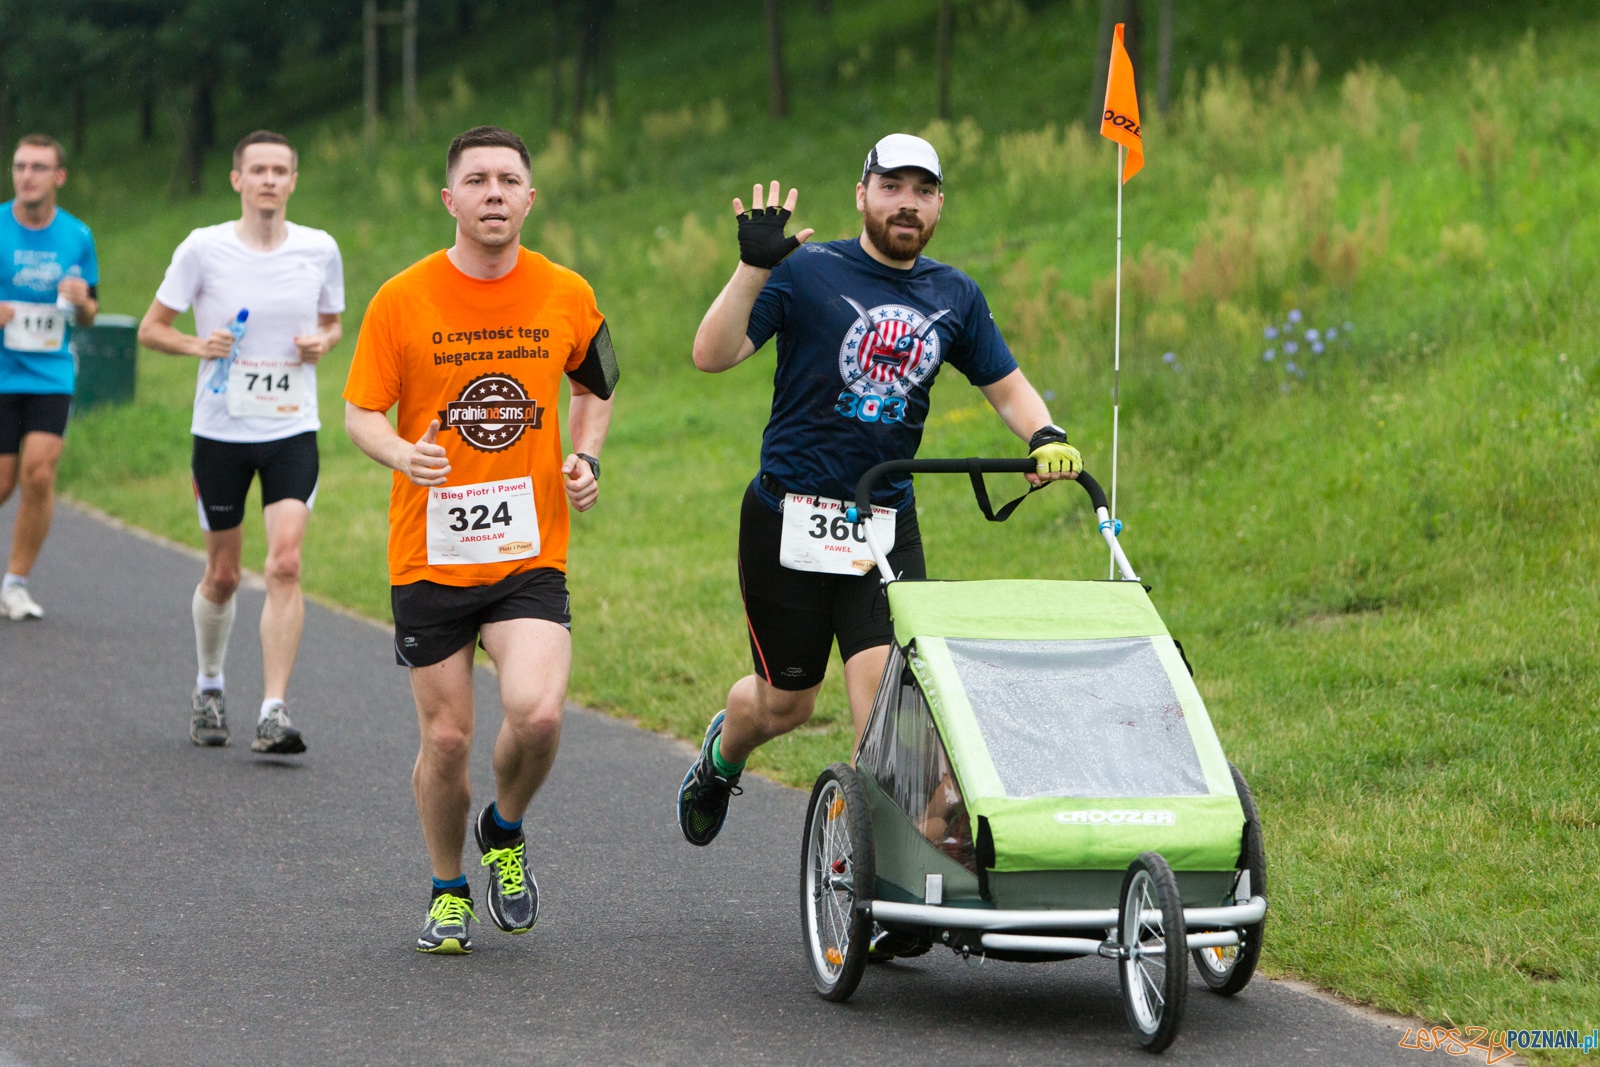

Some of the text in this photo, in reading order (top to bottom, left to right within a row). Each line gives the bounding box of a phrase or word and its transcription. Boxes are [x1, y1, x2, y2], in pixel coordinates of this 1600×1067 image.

[432, 326, 549, 345] O czystość tego
[433, 346, 549, 366] biegacza zadbała
[245, 373, 290, 392] 714
[449, 404, 535, 424] pralnianasms.pl
[834, 391, 908, 424] 303
[441, 491, 464, 500] Bieg
[466, 487, 490, 498] Piotr
[492, 485, 495, 494] i
[498, 482, 527, 493] Paweł
[448, 501, 513, 532] 324
[460, 532, 505, 543] JAROSŁAW
[499, 545, 512, 553] Piotr
[824, 544, 852, 553] PAWEŁ
[1055, 809, 1175, 825] CROOZER
